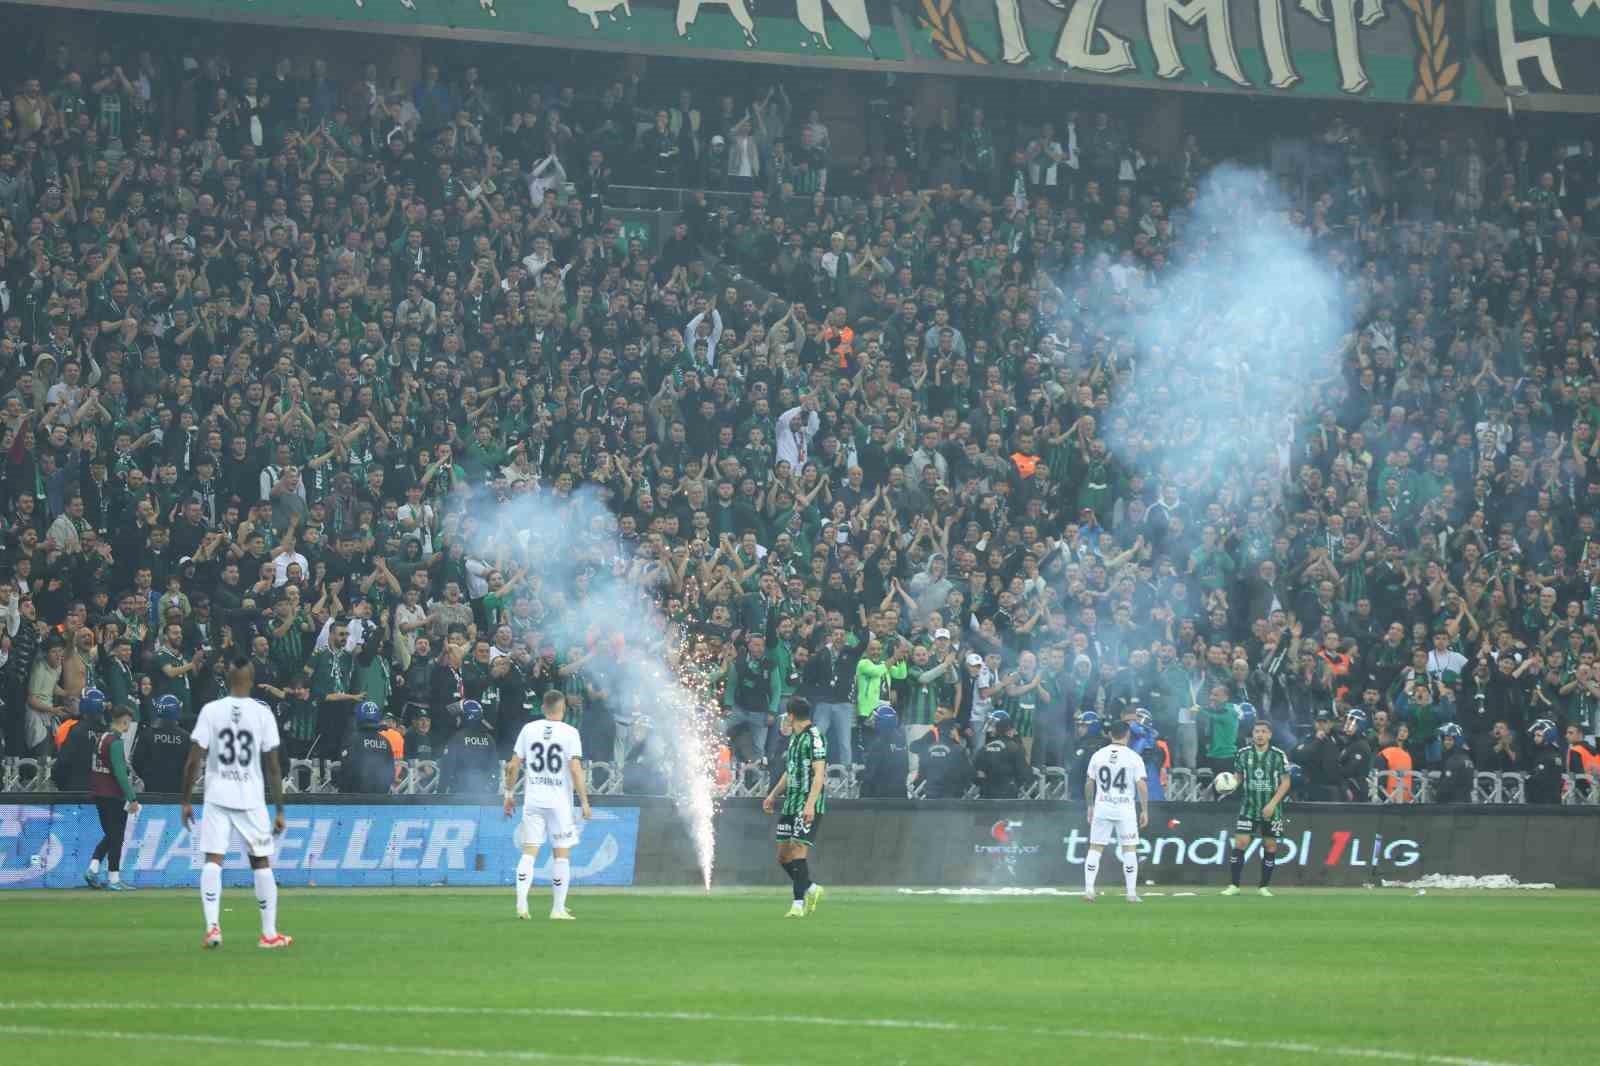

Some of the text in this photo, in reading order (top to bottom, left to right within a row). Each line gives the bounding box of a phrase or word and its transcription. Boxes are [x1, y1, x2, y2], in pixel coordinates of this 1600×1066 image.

[153, 733, 182, 745] POLIS
[218, 728, 253, 767] 33
[464, 736, 489, 746] POLIS
[530, 742, 563, 774] 36
[1098, 766, 1127, 794] 94
